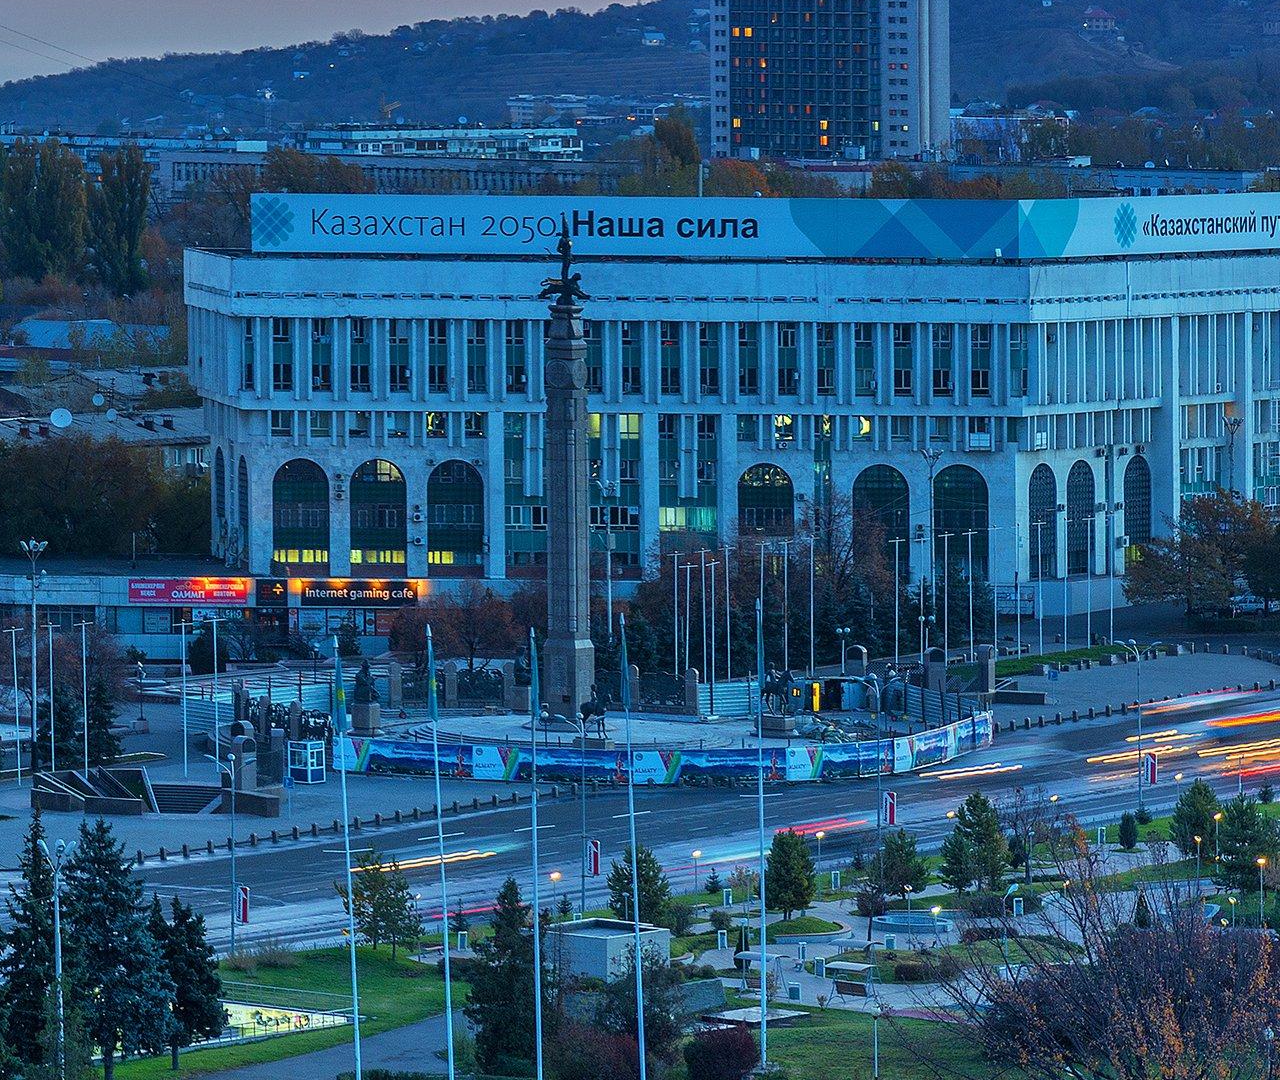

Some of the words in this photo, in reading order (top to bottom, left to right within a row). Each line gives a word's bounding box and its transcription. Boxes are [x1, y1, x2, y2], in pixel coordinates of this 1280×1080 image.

[311, 208, 465, 237] Казахстан
[481, 215, 557, 244] 2050
[572, 209, 665, 238] Наша
[678, 213, 760, 239] сила
[1142, 210, 1257, 238] «Казахстанский
[171, 590, 205, 599] ОЛИМП
[305, 587, 348, 598] internet
[349, 587, 390, 600] gaming
[391, 587, 414, 598] cafe
